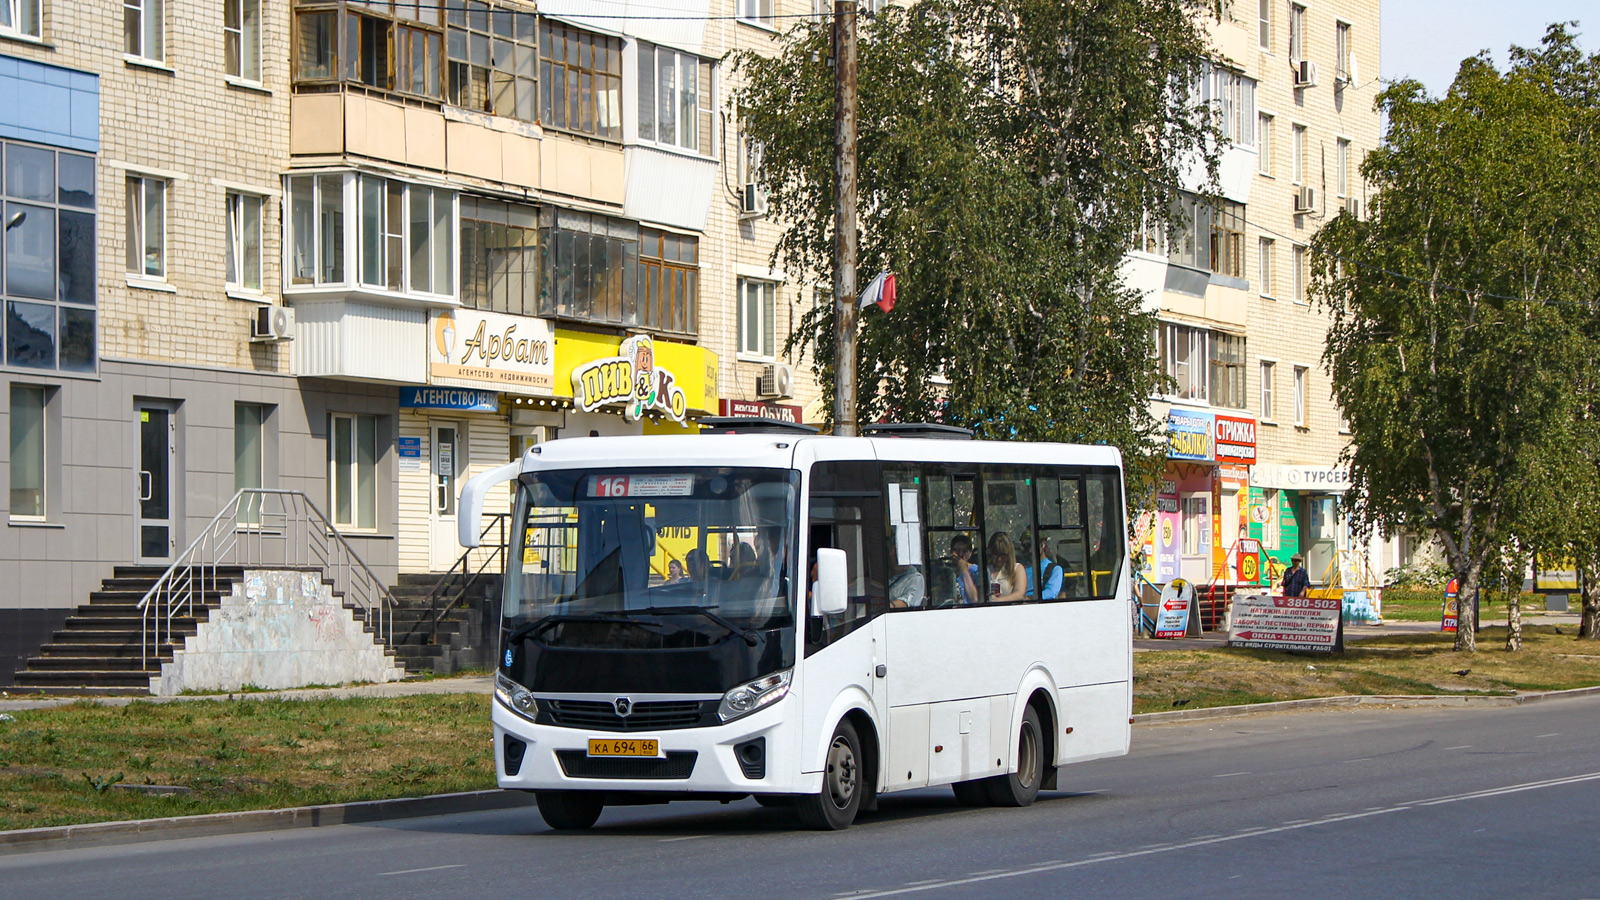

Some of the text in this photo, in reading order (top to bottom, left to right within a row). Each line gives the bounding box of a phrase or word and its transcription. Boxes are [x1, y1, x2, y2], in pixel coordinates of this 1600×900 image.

[461, 319, 548, 367] Арбат
[458, 368, 548, 384] АГЕНТСТВО НЕДВИЖИМОСТИ
[582, 361, 632, 407] ПИВ
[413, 389, 475, 406] АГЕНТСТВО
[760, 405, 796, 424] ОБУВЬ
[1216, 419, 1255, 444] СТРИЖКА
[1170, 431, 1207, 456] РЫБАЛКИ
[600, 478, 625, 497] 16
[1287, 599, 1337, 609] 380-502
[1265, 620, 1303, 628] ЛЕСТНИЦЫ
[1306, 622, 1335, 630] ПЕРИЛА
[613, 741, 636, 753] 694
[642, 741, 654, 750] 66
